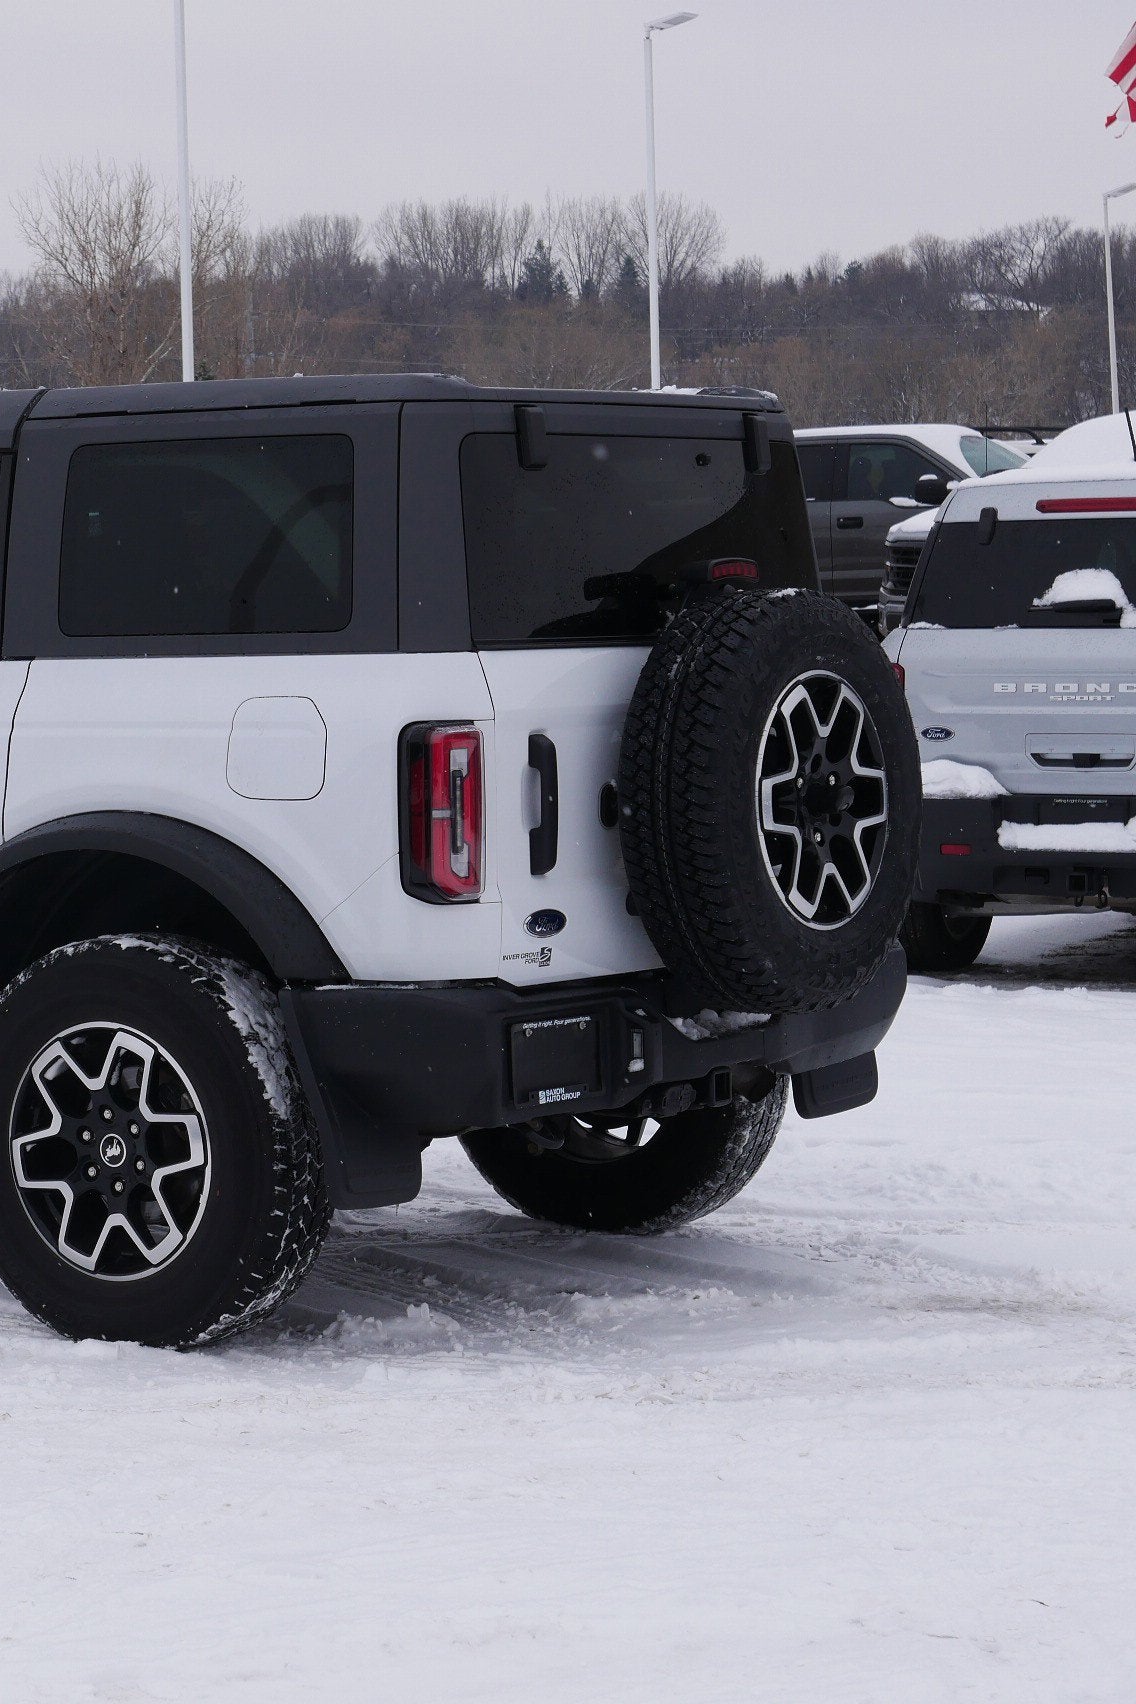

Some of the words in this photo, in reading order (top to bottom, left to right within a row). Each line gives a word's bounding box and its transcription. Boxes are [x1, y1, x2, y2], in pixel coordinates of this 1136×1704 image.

[545, 1087, 565, 1096] SAXON
[546, 1095, 561, 1103] AUTO
[561, 1091, 581, 1100] GROUP
